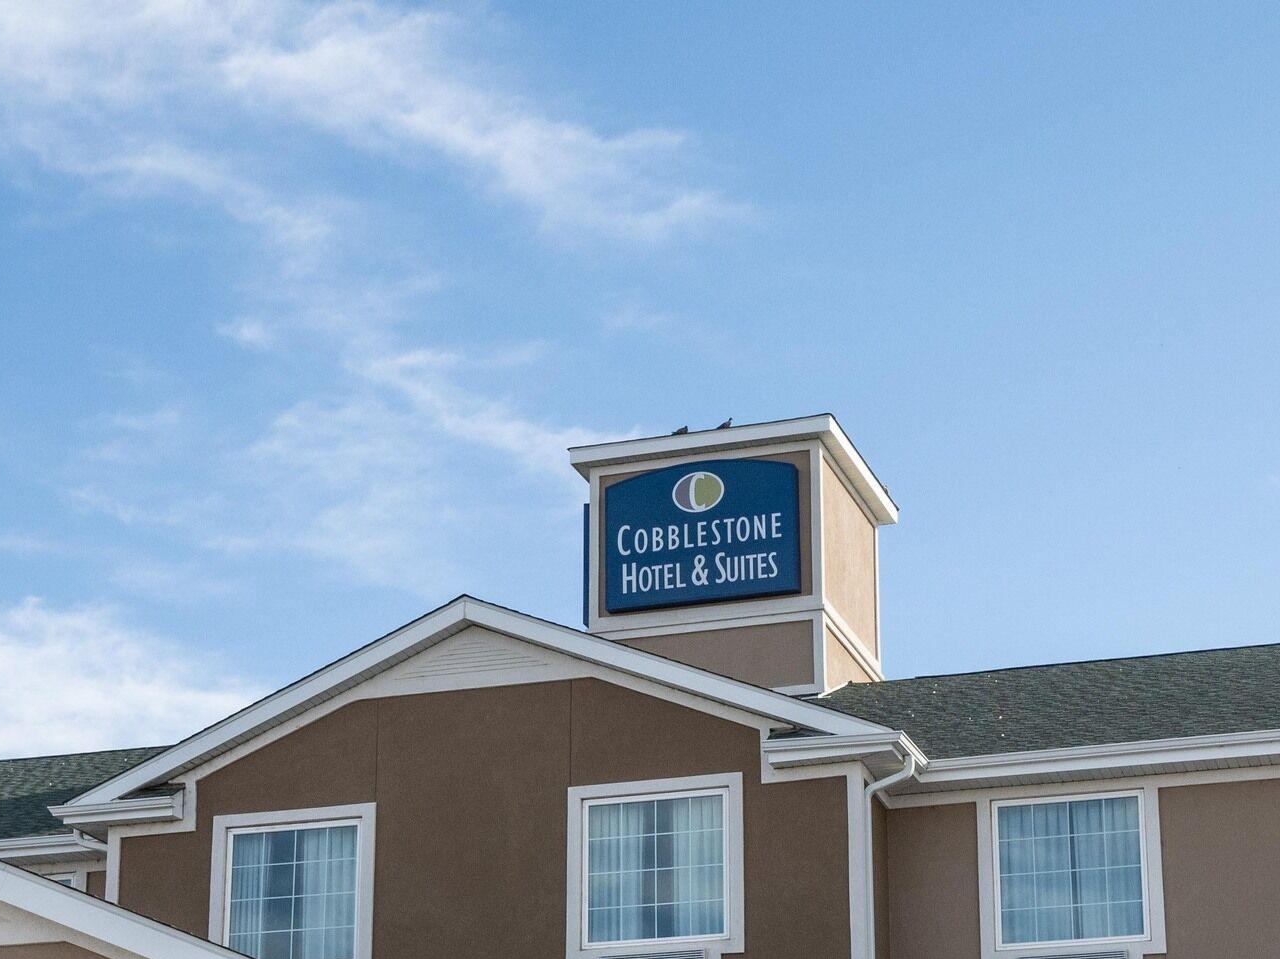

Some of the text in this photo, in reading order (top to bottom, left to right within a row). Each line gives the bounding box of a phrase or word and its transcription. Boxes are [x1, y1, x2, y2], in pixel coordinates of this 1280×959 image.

[617, 512, 782, 556] COBBLESTONE
[622, 552, 778, 594] HOTEL & SUITES
